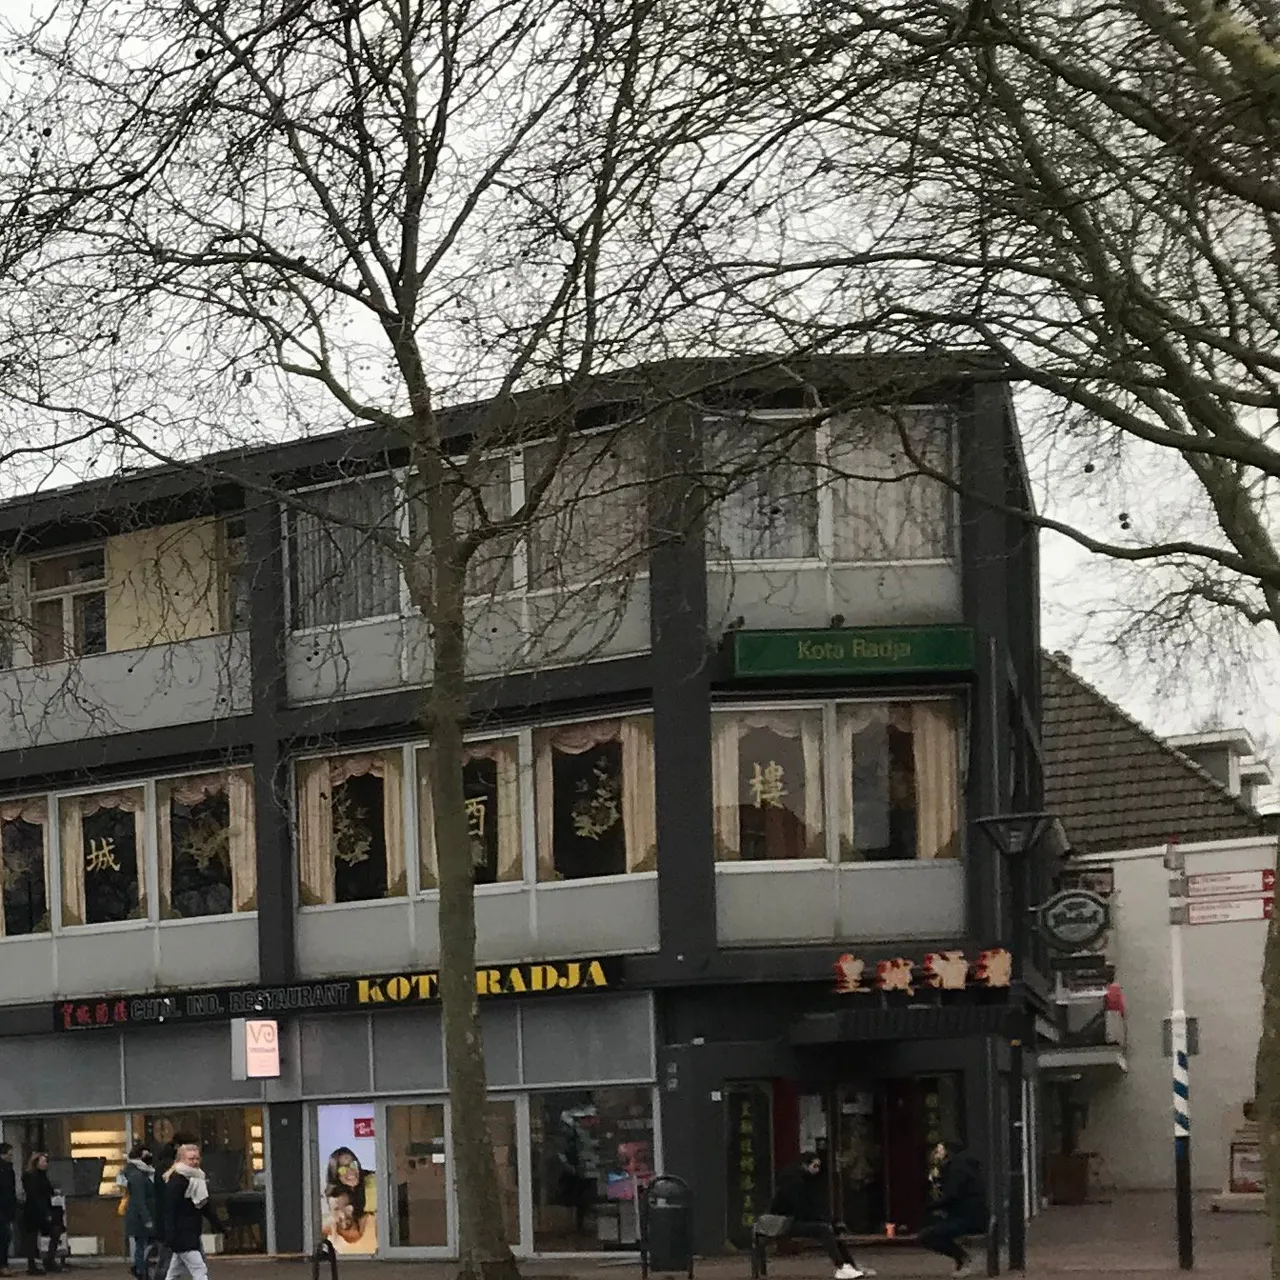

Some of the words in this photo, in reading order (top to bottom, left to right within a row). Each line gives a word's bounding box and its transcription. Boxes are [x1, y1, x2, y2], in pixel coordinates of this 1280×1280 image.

[797, 640, 845, 660] Kota
[851, 638, 912, 661] Radja
[85, 836, 121, 873] 城
[186, 993, 225, 1016] IND.
[229, 982, 351, 1013] RESTAURANT
[356, 973, 441, 1004] KOT
[475, 959, 608, 995] RADJA
